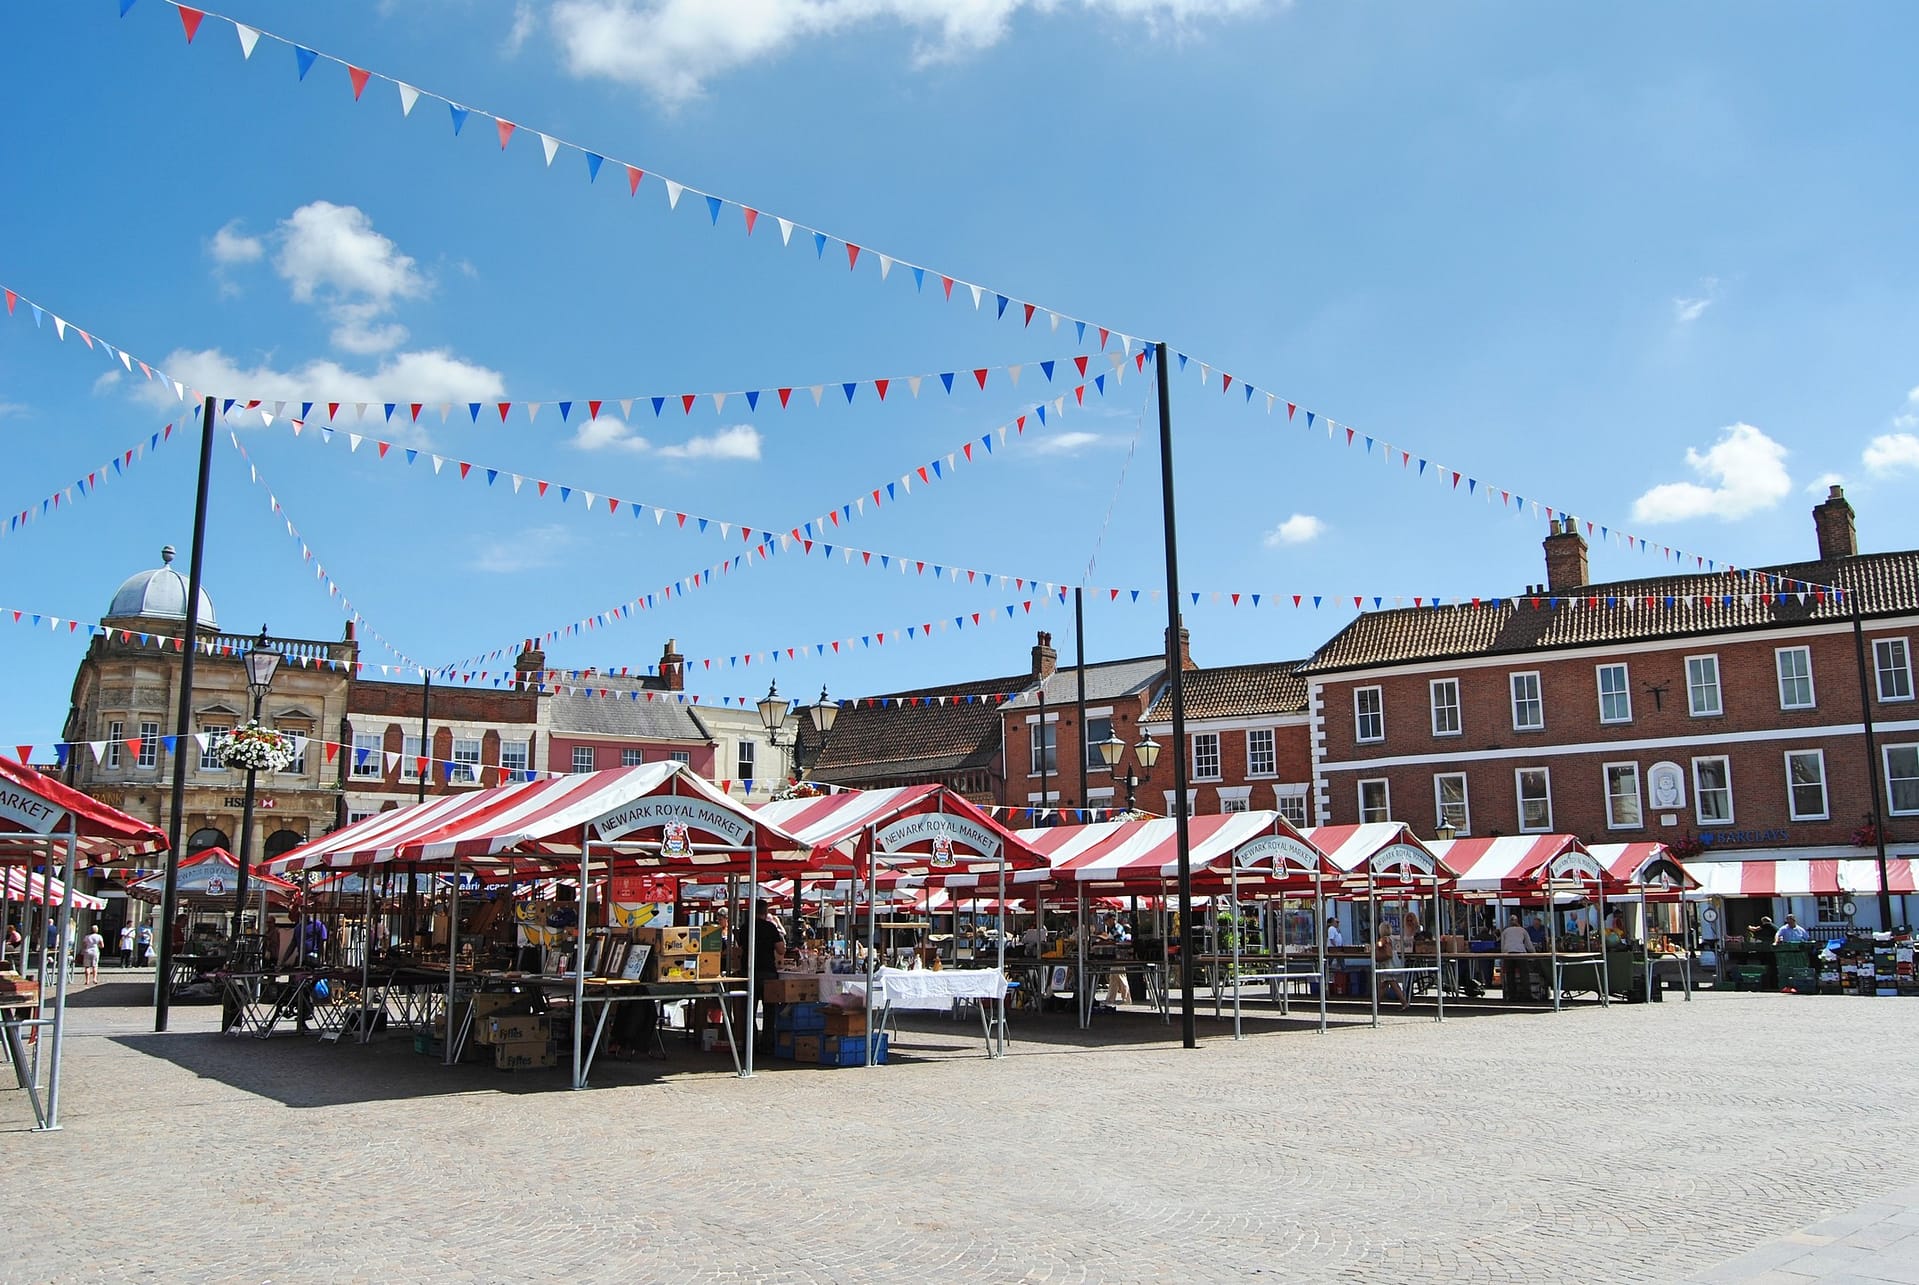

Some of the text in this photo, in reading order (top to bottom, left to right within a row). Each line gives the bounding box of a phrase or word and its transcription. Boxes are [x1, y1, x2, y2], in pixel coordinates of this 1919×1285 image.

[601, 804, 744, 838] NEWARK ROYAL MARKET
[885, 821, 995, 849] NEWARK ROYAL MARKET
[1717, 828, 1789, 843] BARCLAYS
[1240, 841, 1313, 863] NEWARK ROYAL MARKET
